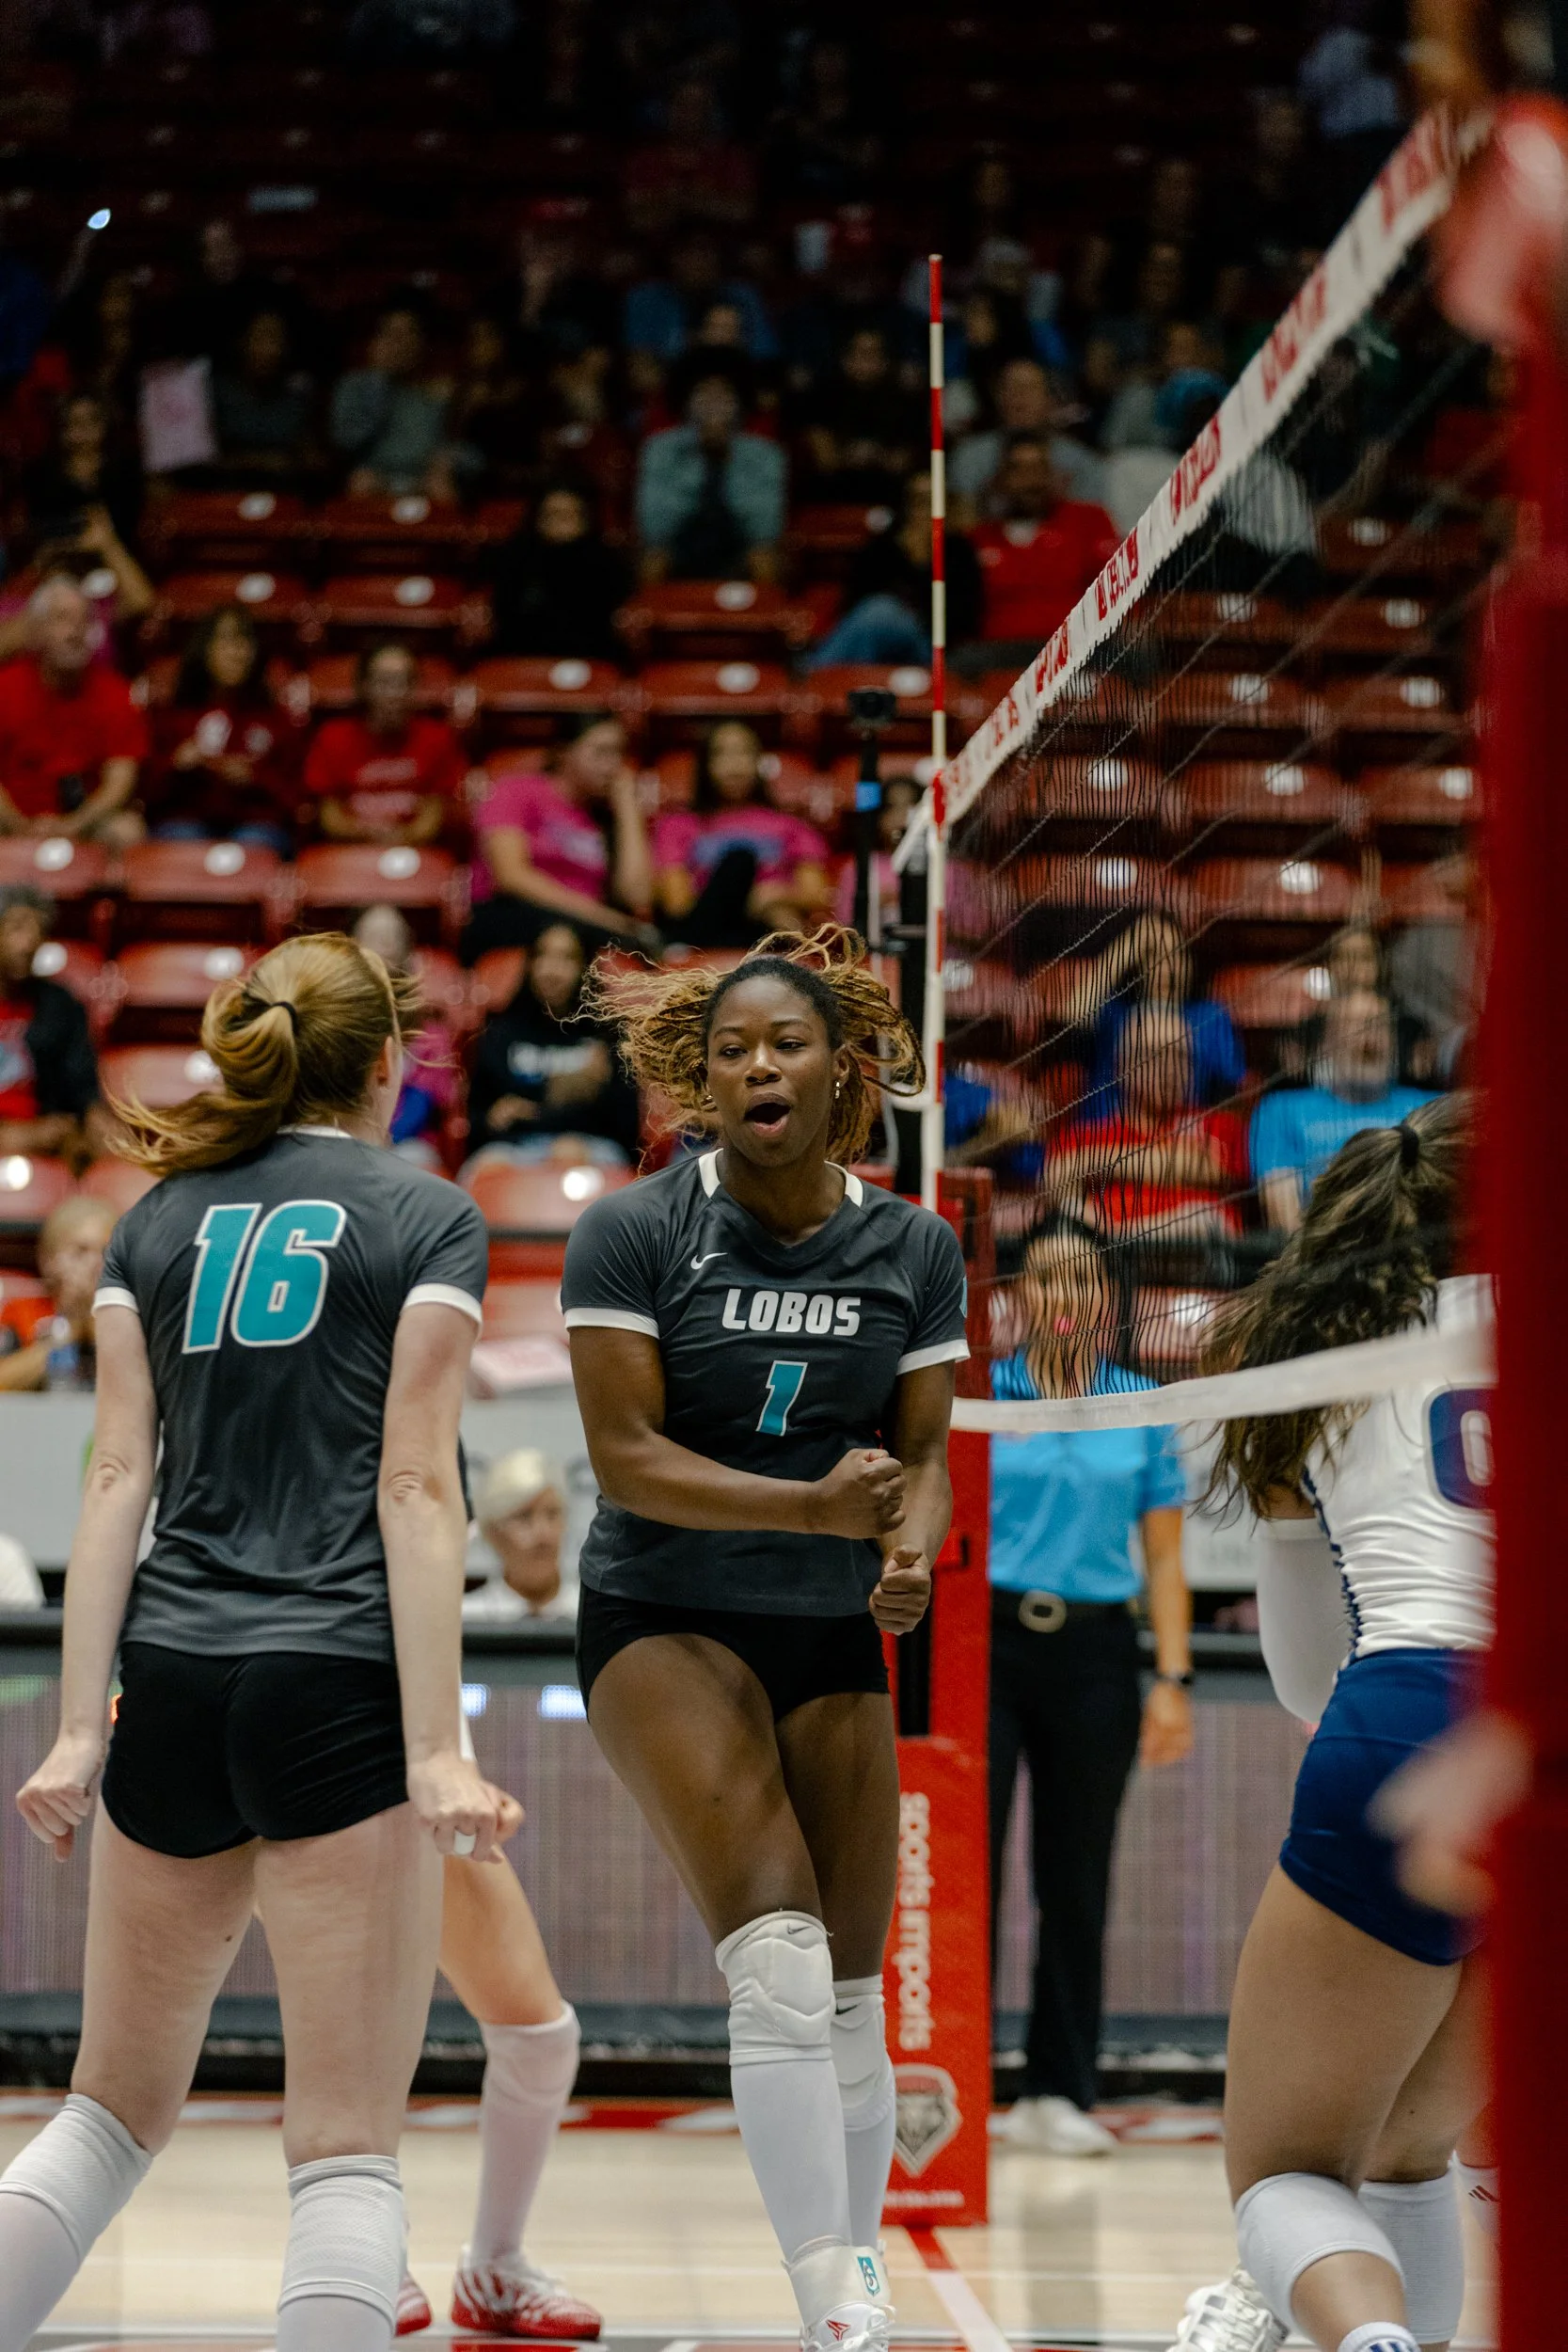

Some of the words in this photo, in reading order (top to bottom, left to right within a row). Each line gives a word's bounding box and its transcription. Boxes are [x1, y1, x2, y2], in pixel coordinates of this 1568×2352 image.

[182, 1199, 347, 1355] 16
[721, 1288, 862, 1337] LOBOS
[755, 1359, 808, 1438] 1
[898, 1790, 936, 1908] sports
